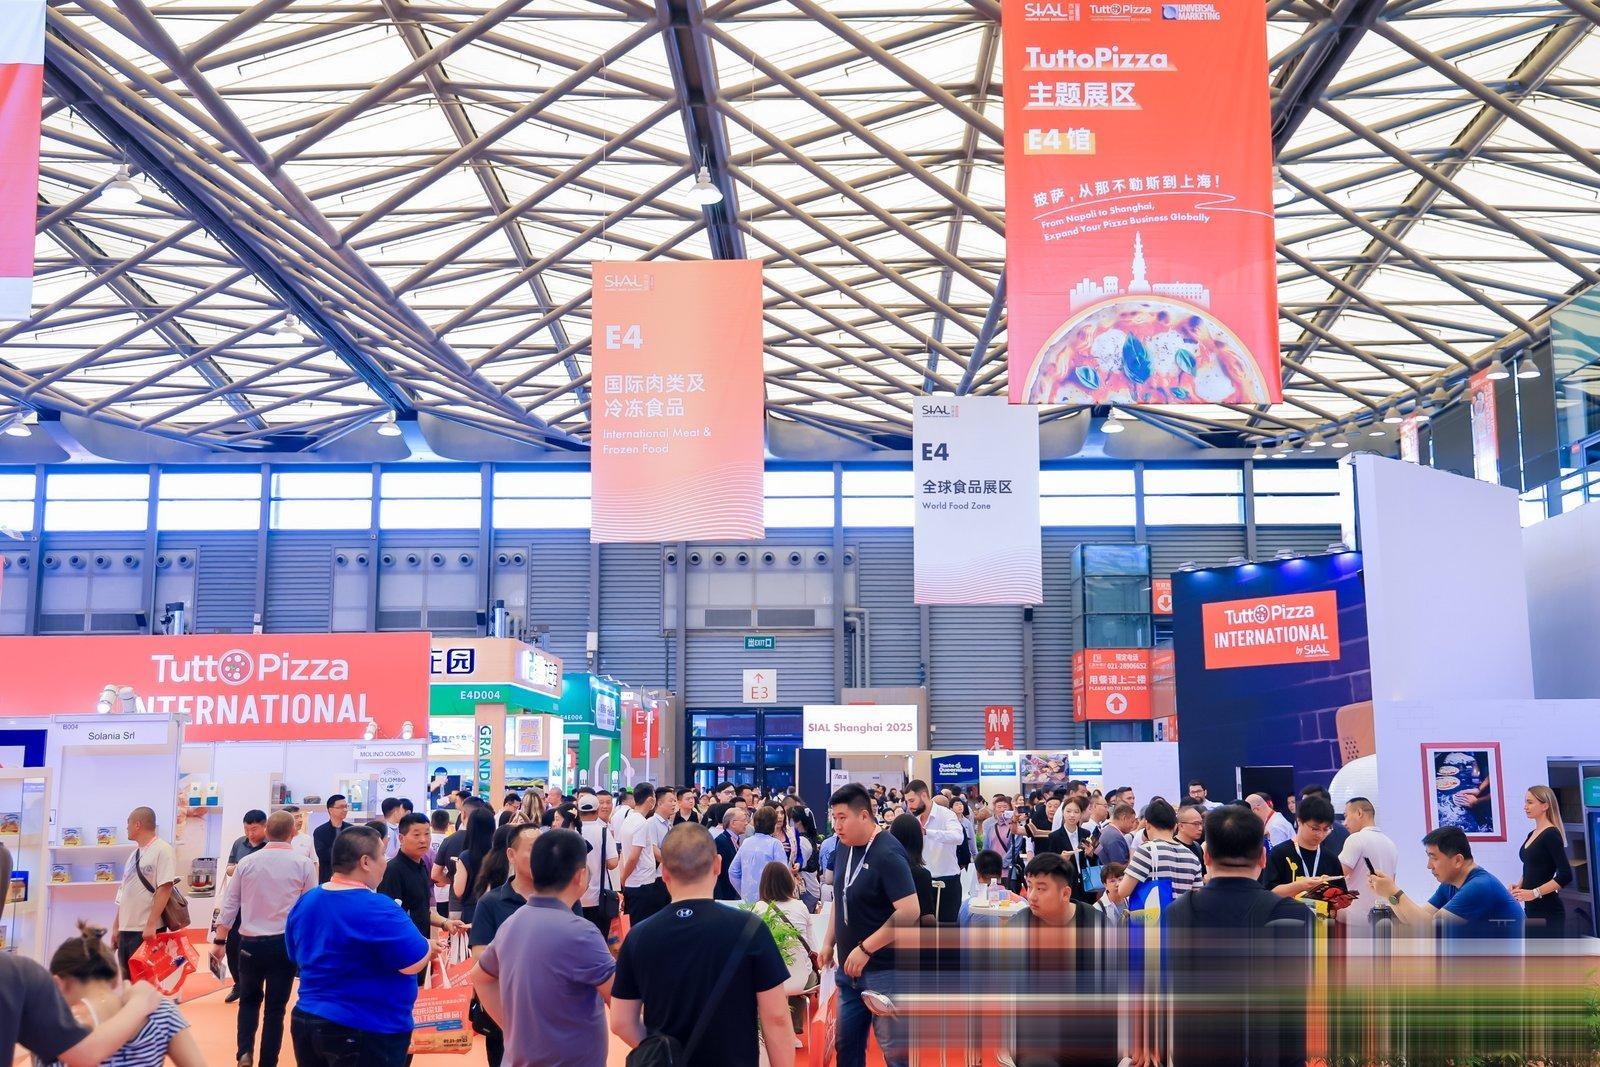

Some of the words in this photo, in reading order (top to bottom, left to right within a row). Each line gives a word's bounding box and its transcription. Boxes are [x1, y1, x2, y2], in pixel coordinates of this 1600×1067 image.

[1178, 3, 1215, 12] UNIVERSAL
[1178, 11, 1221, 20] MARKETING
[1026, 46, 1168, 69] TuttoPizza
[1028, 81, 1136, 108] 主题展区
[1041, 219, 1064, 229] From
[1066, 210, 1097, 224] Napoli
[1098, 209, 1108, 217] to
[1109, 202, 1155, 215] Shanghai,
[1044, 227, 1079, 241] Expand
[1080, 223, 1102, 233] Your
[1103, 219, 1128, 229] Pizza
[1129, 213, 1168, 225] Business
[1170, 212, 1210, 224] Globally
[605, 324, 643, 350] E4
[604, 373, 706, 394] 国际肉类及
[604, 397, 685, 418] 冷冻食品
[922, 404, 951, 415] SIAL
[603, 427, 669, 440] International
[672, 427, 700, 437] Meat
[703, 426, 712, 437] &
[603, 444, 639, 455] Frozen
[642, 443, 669, 454] Food
[922, 442, 949, 461] E4
[922, 479, 1013, 495] 全球食品展区
[922, 502, 947, 510] World
[949, 502, 969, 510] Food
[971, 502, 991, 510] Zone
[1214, 622, 1329, 649] INTERNATIONAL
[1295, 646, 1303, 656] by
[460, 690, 501, 700] E4D004
[751, 686, 768, 699] E3
[135, 693, 374, 725] NTERNATIONAL
[88, 731, 120, 740] Solania
[123, 731, 136, 740] Srl
[808, 723, 831, 732] SIAL
[833, 722, 883, 735] Shanghai
[886, 722, 913, 732] 2025
[479, 725, 492, 781] GRAND
